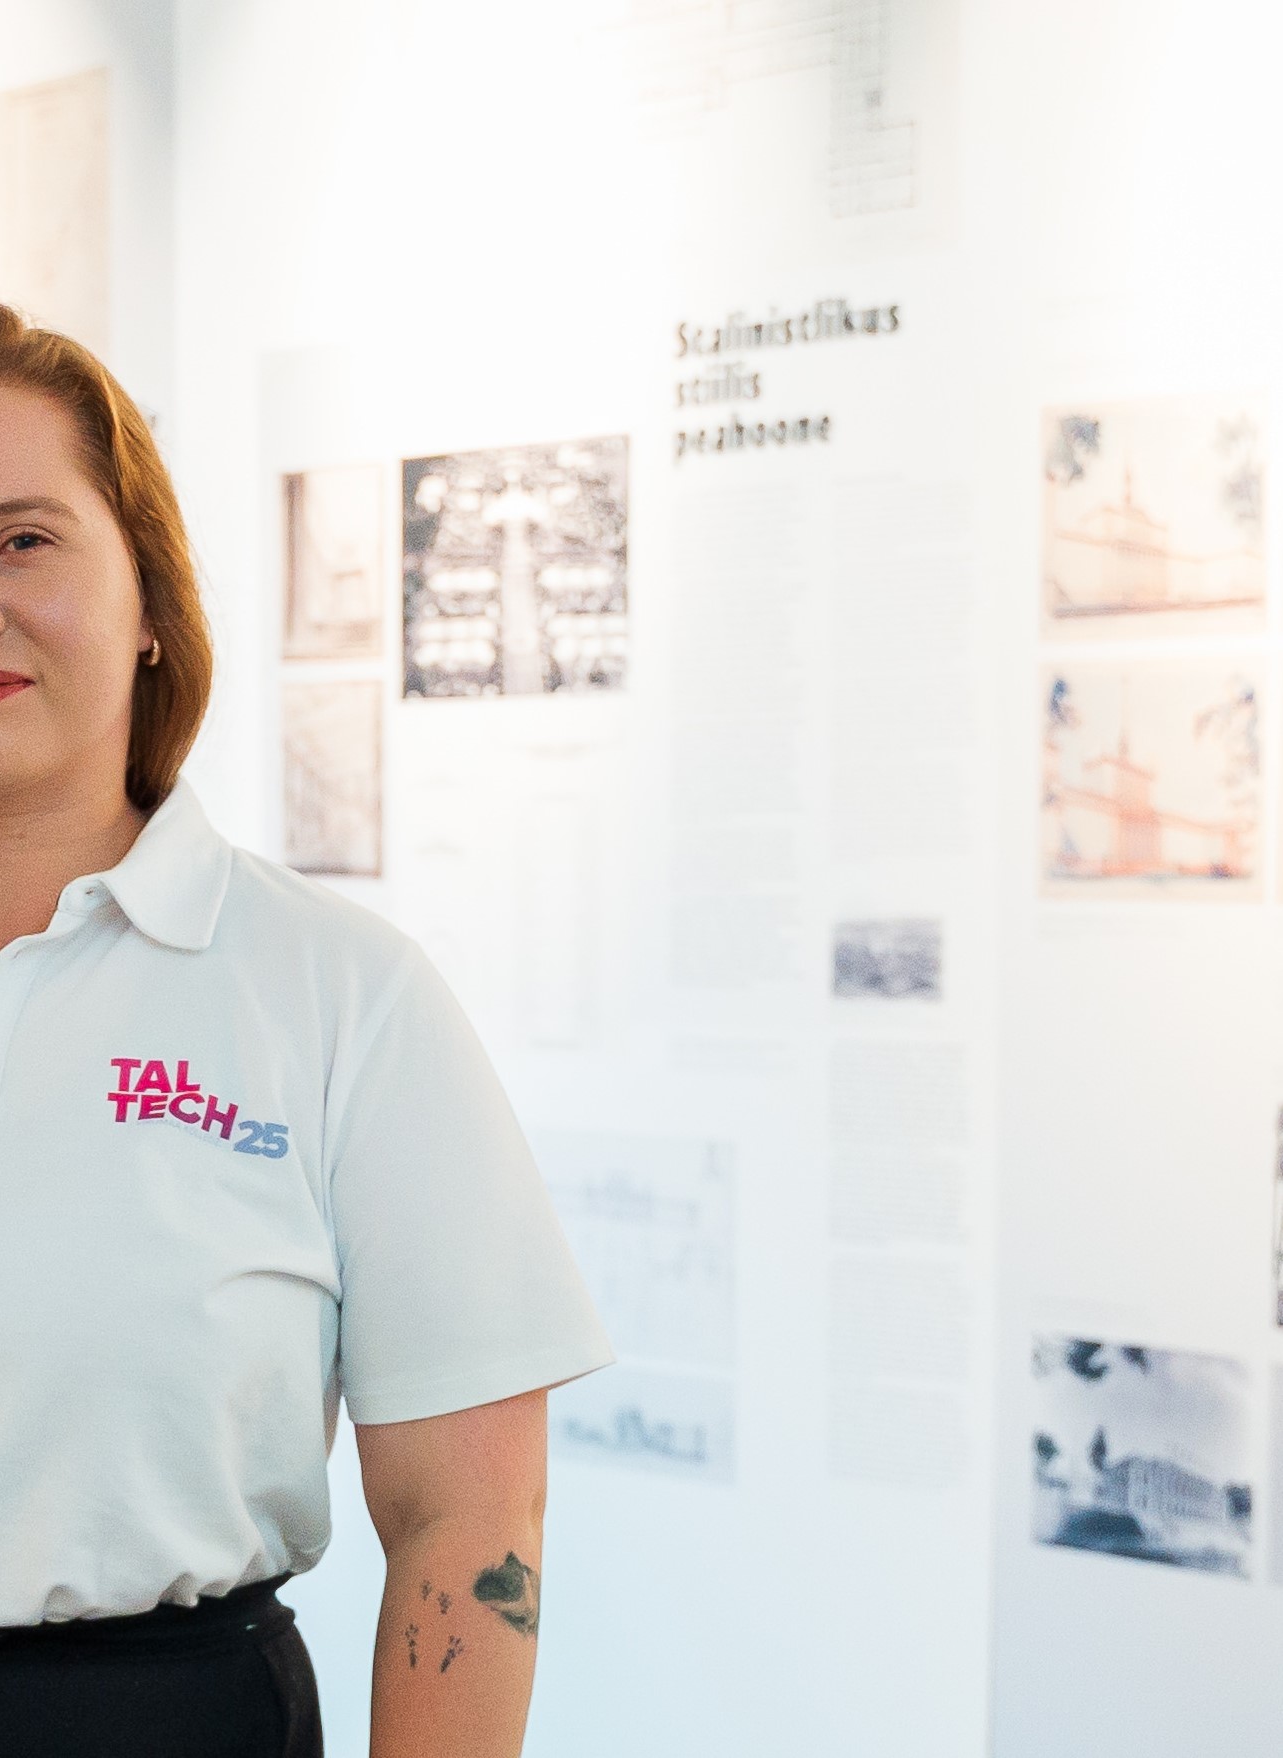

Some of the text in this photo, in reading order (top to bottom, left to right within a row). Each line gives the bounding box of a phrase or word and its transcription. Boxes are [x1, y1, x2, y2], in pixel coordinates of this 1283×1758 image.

[111, 1058, 201, 1093] TAL
[107, 1092, 289, 1160] TECH 25
